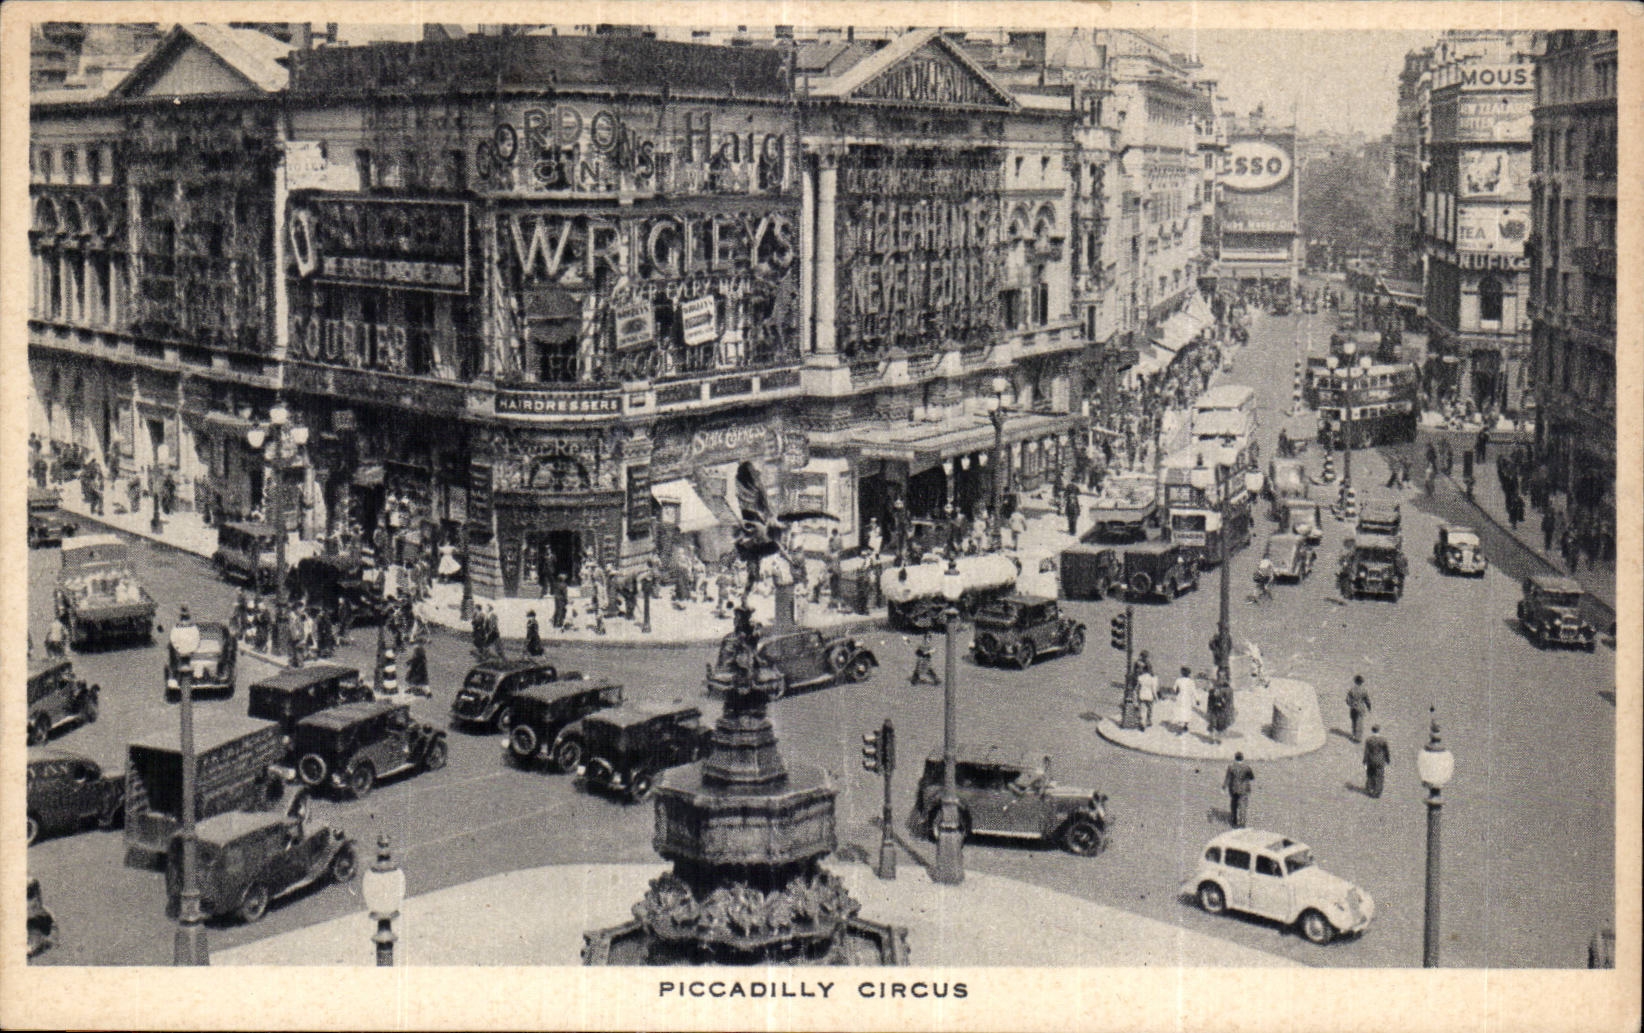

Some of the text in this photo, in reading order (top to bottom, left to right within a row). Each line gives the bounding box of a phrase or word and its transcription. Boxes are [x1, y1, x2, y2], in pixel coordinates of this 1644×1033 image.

[1461, 68, 1535, 85] MOUS
[683, 110, 785, 187] Haig
[1221, 150, 1283, 175] ESSO
[1460, 226, 1486, 239] TEA
[500, 399, 618, 412] HAIRDRESSERS
